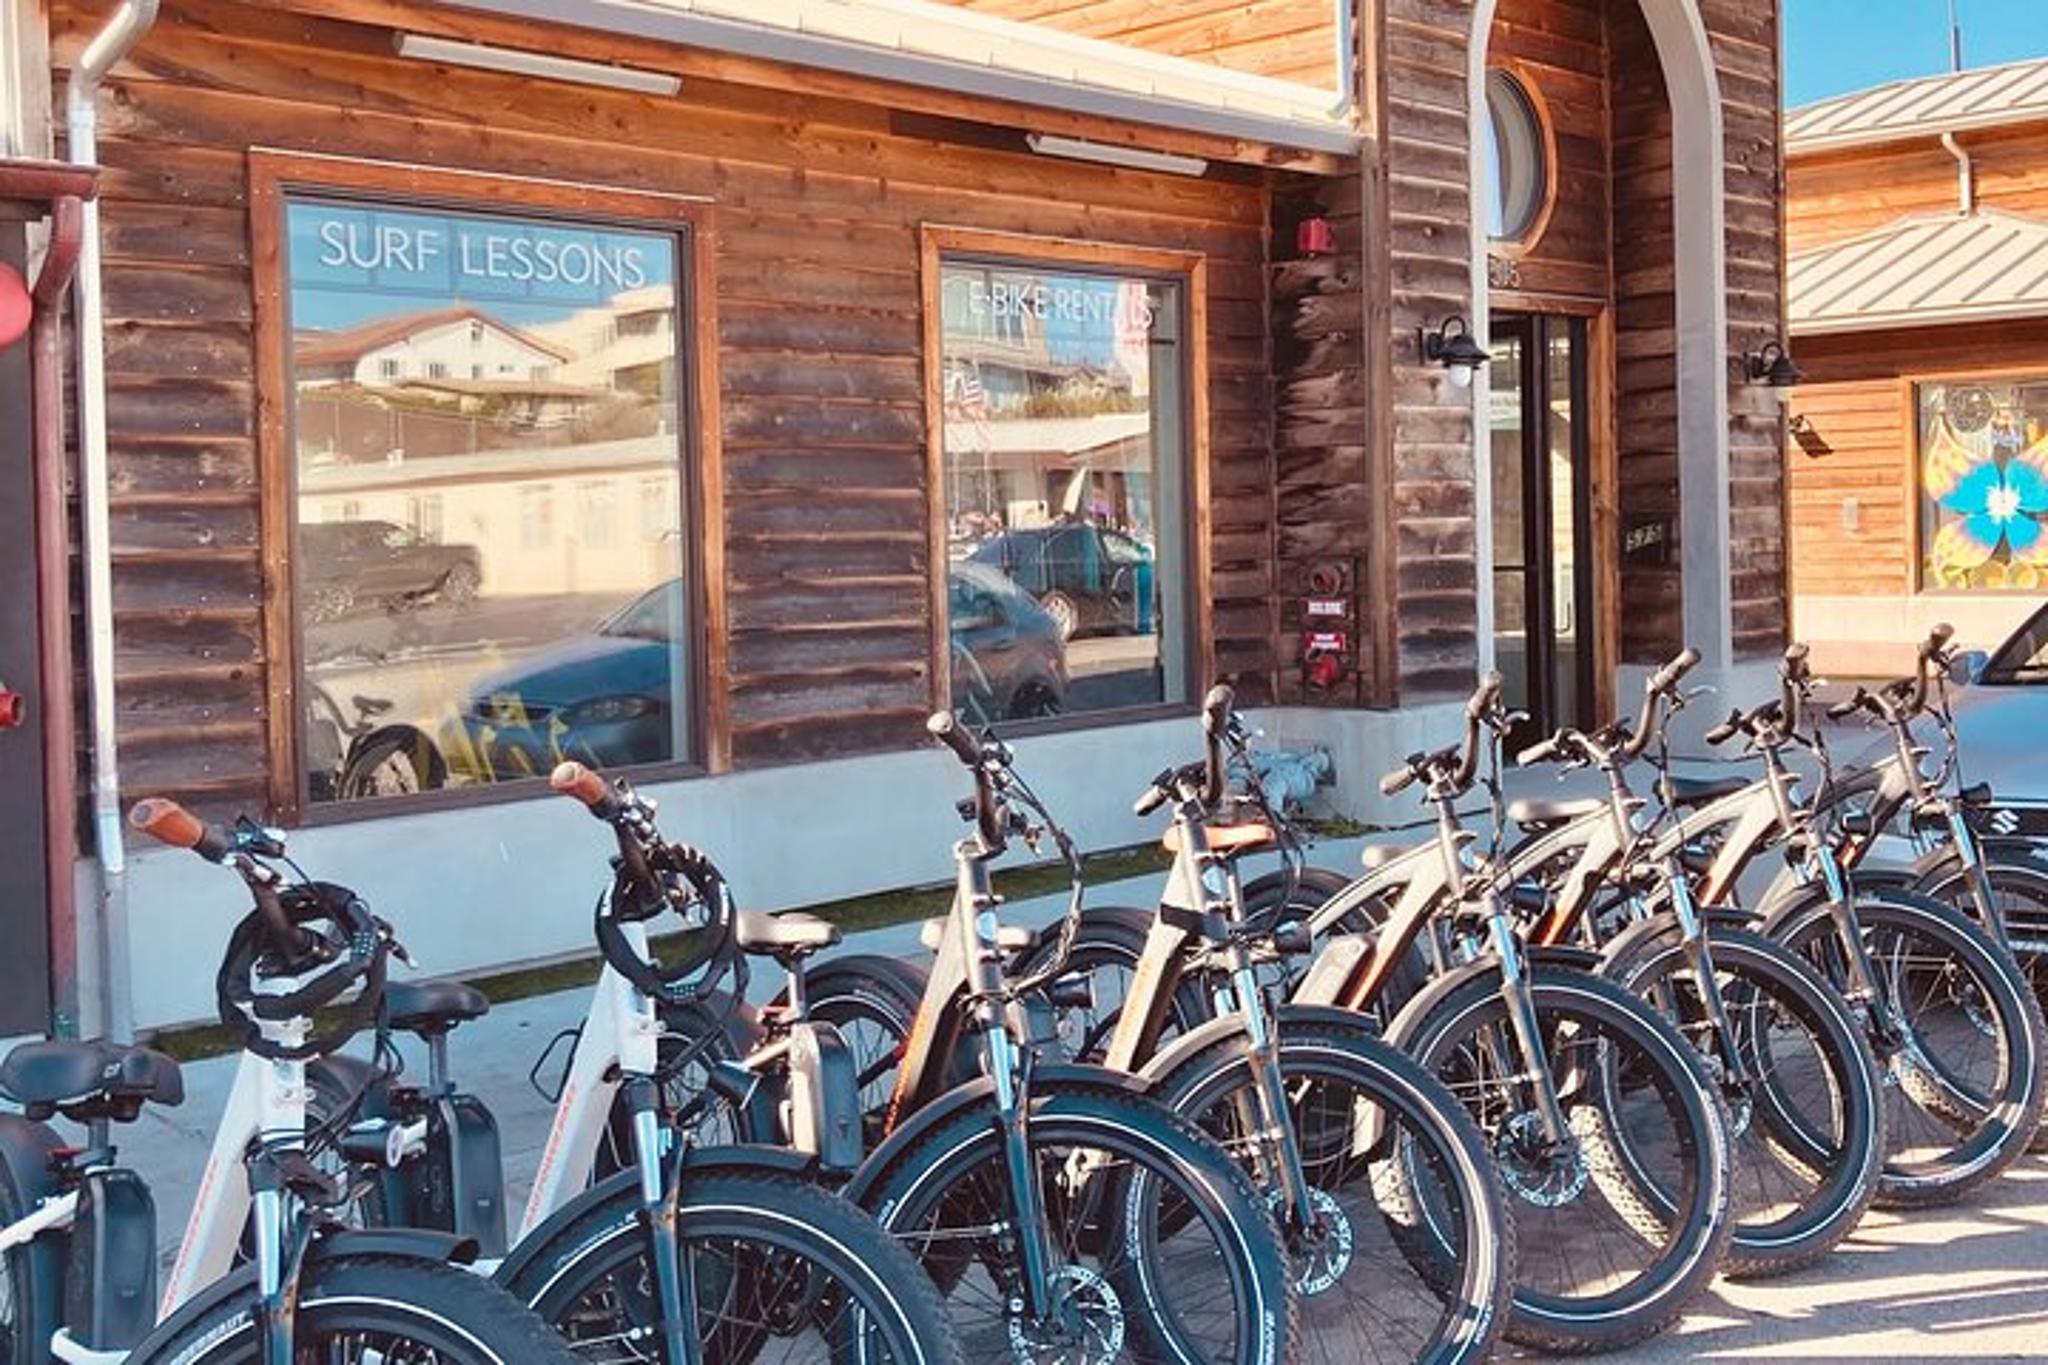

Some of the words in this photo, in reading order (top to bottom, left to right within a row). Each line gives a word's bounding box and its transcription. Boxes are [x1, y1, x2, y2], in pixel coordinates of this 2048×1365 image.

[320, 220, 439, 272] SURF
[459, 231, 645, 288] LESSONS
[1055, 287, 1153, 332] RENTLS
